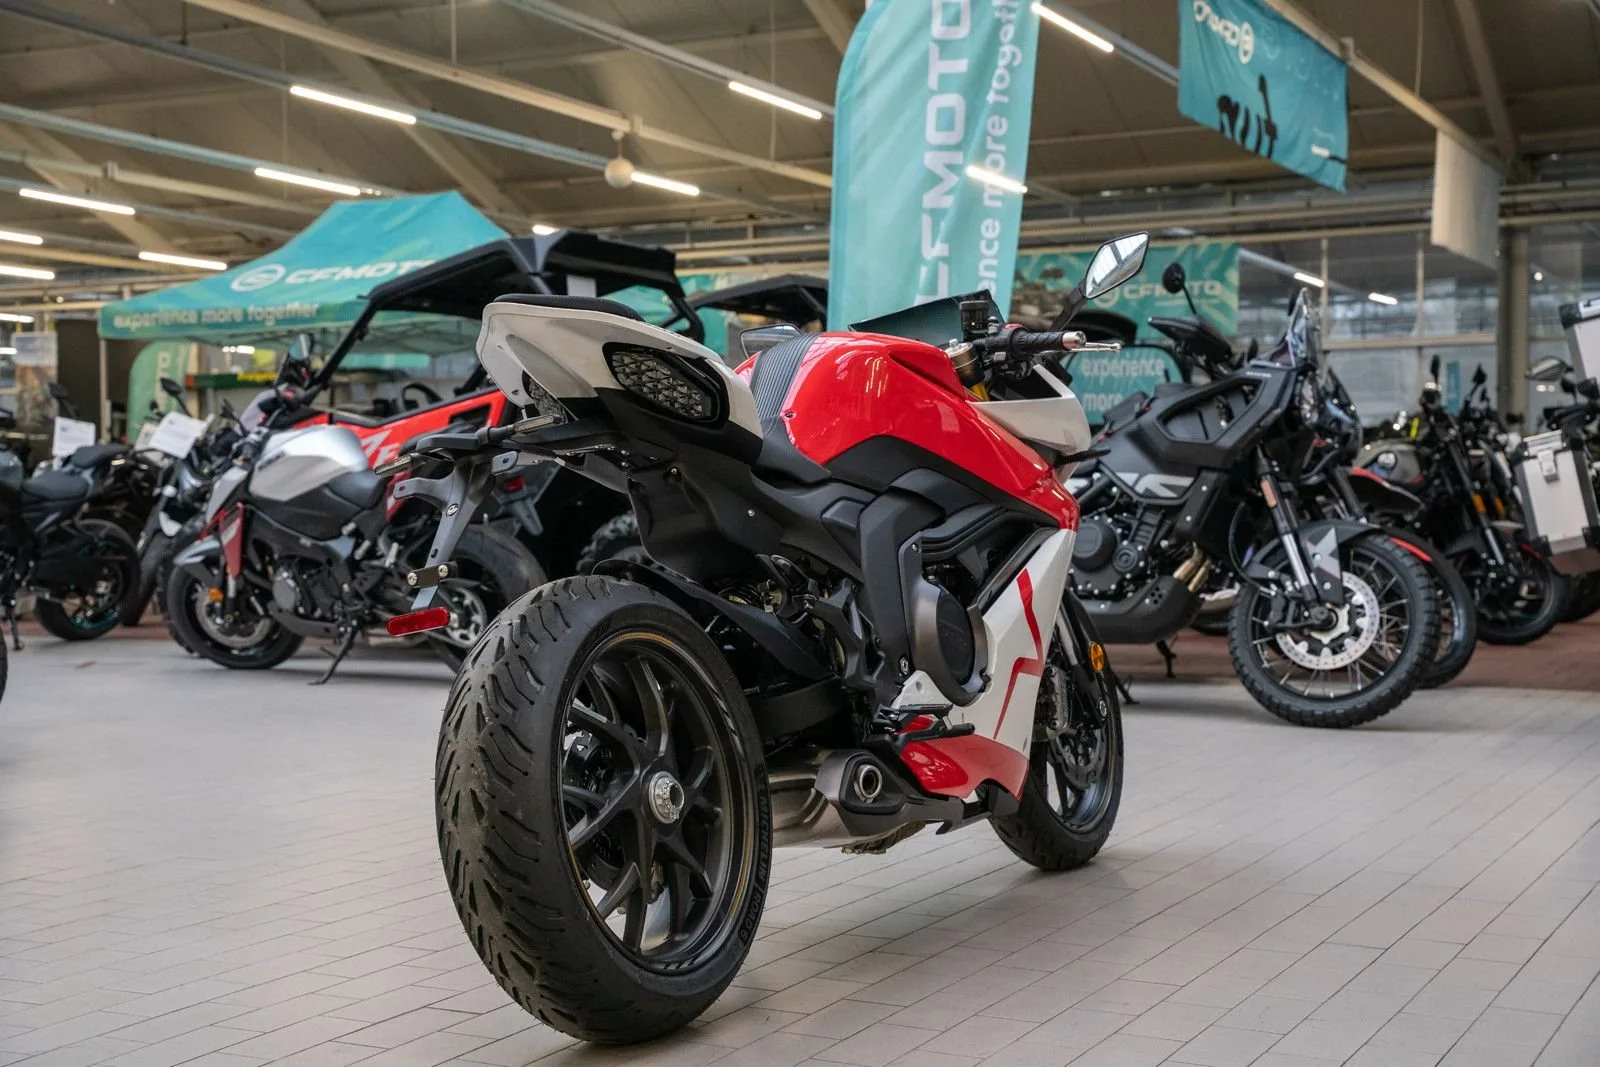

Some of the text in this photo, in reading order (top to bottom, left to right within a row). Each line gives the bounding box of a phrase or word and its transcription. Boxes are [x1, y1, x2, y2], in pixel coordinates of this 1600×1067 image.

[1123, 280, 1222, 299] CFMTO
[1081, 358, 1164, 381] experience
[758, 796, 770, 881] MICHELIN
